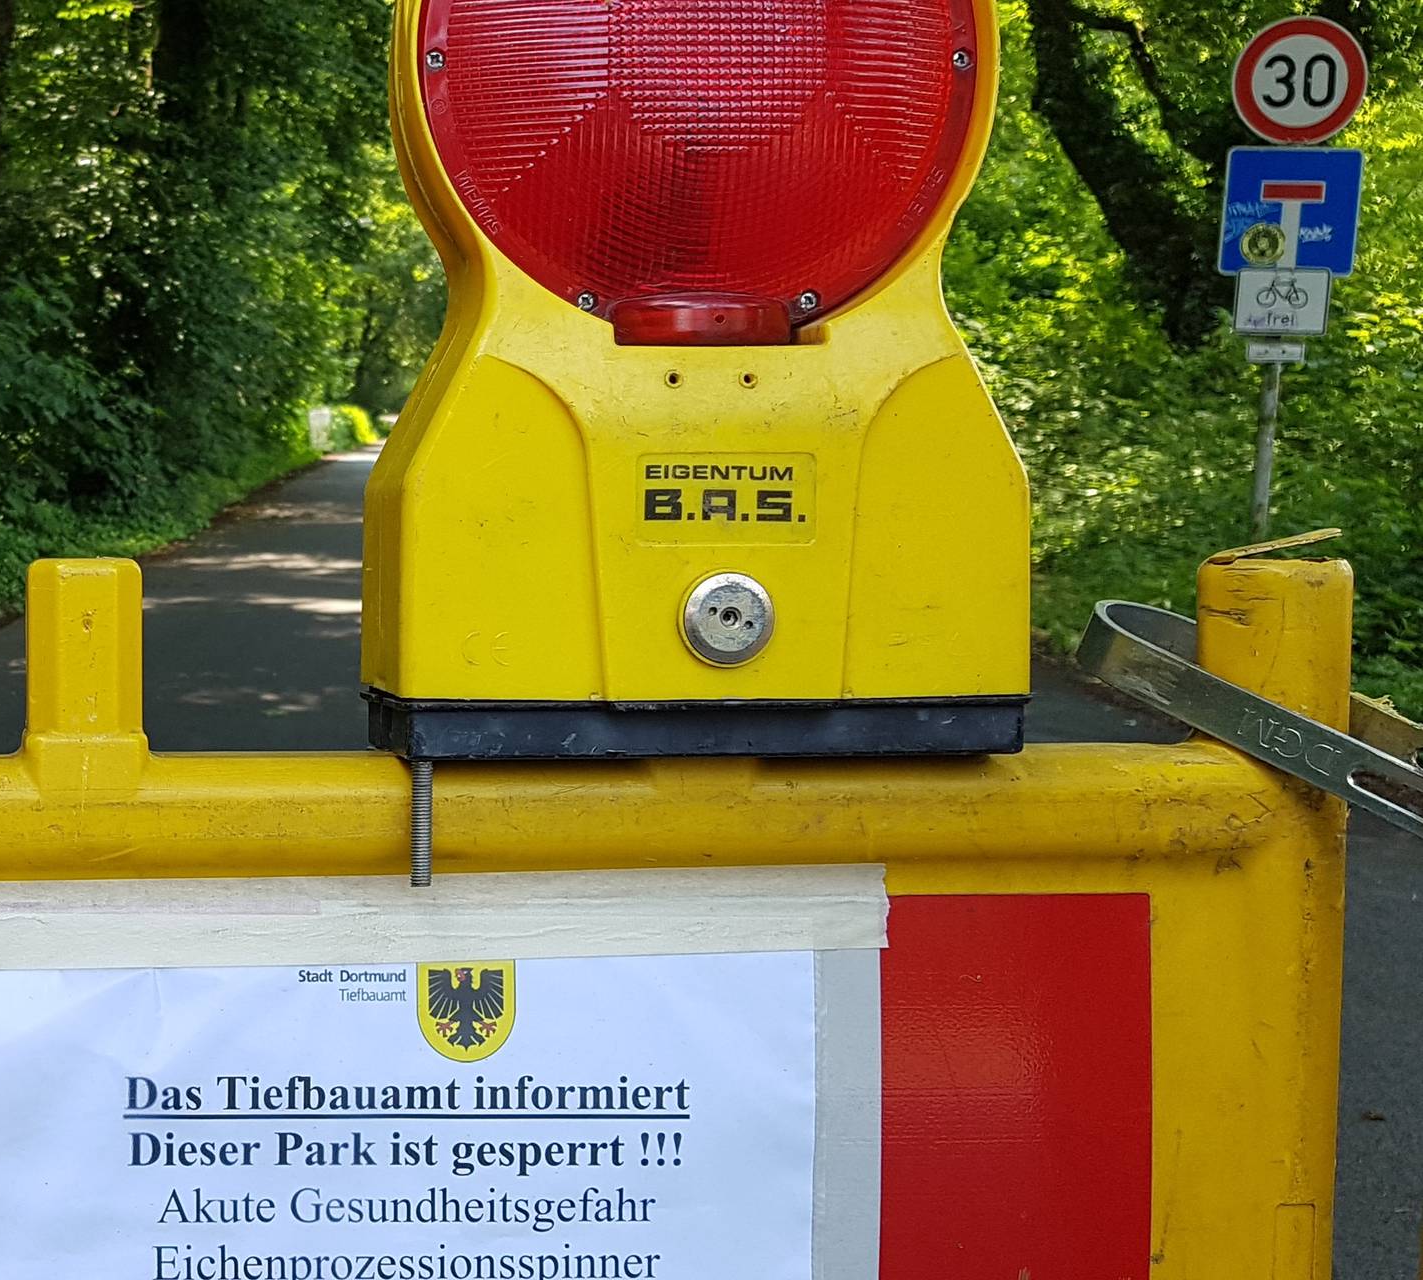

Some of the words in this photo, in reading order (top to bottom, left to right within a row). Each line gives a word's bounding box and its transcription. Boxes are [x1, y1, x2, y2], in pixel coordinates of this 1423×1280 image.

[1262, 53, 1337, 108] 30
[644, 464, 794, 481] EIGENTUM
[643, 488, 807, 523] B.A.S.
[297, 968, 334, 983] Stadt
[339, 968, 407, 983] Dortmund
[338, 987, 407, 1002] Tiefbauamt
[126, 1076, 203, 1111] Das
[216, 1075, 461, 1111] Tiefbauamt
[473, 1075, 690, 1111] informiert
[128, 1131, 261, 1167] Dieser
[274, 1132, 377, 1167] Park
[390, 1131, 439, 1167] ist
[451, 1135, 625, 1177] gesperrt
[640, 1132, 683, 1167] !!!
[157, 1187, 276, 1224] Akute
[290, 1186, 657, 1233] Gesundheitsgefahr
[152, 1243, 662, 1280] Eichenprozessionsspinner
